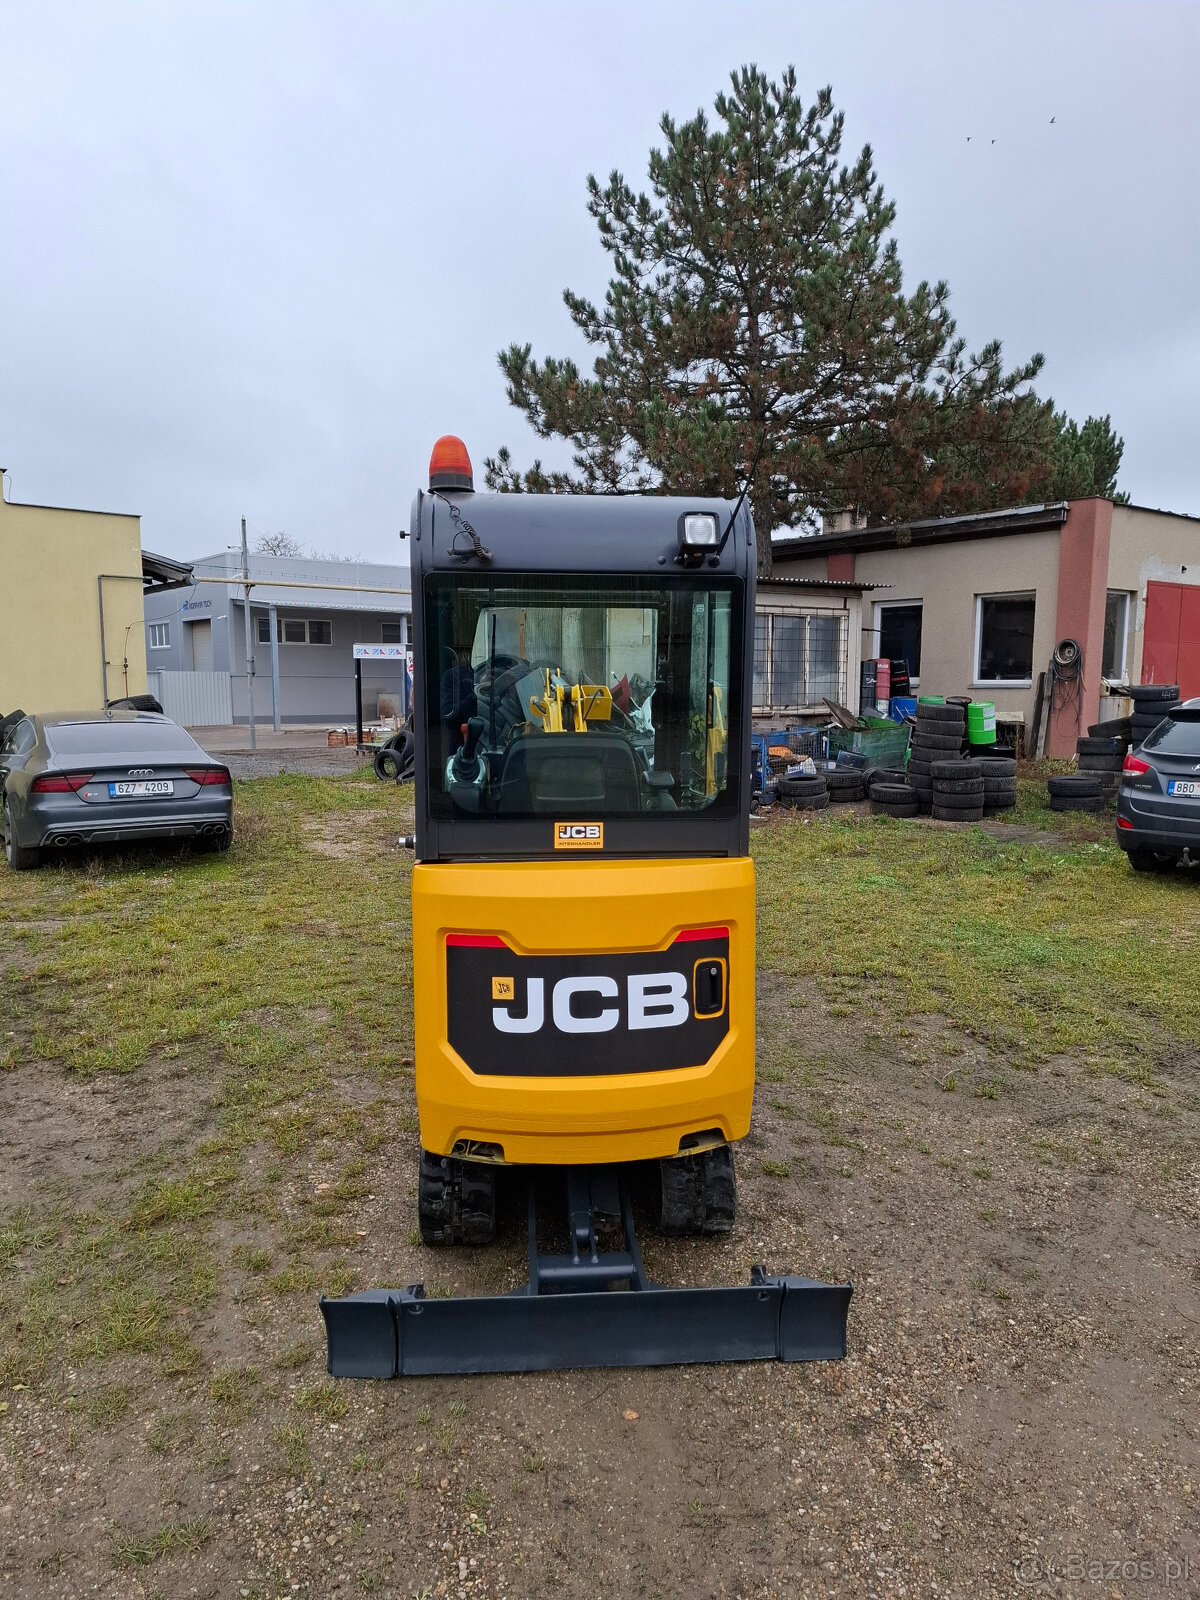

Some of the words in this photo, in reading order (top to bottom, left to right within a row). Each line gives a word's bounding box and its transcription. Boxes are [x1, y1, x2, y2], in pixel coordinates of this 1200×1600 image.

[118, 783, 136, 794] 6Z7
[145, 782, 169, 792] 4209
[1176, 783, 1195, 793] 8B0
[559, 826, 600, 838] JCB
[497, 982, 511, 994] JCB
[492, 972, 690, 1034] JCB
